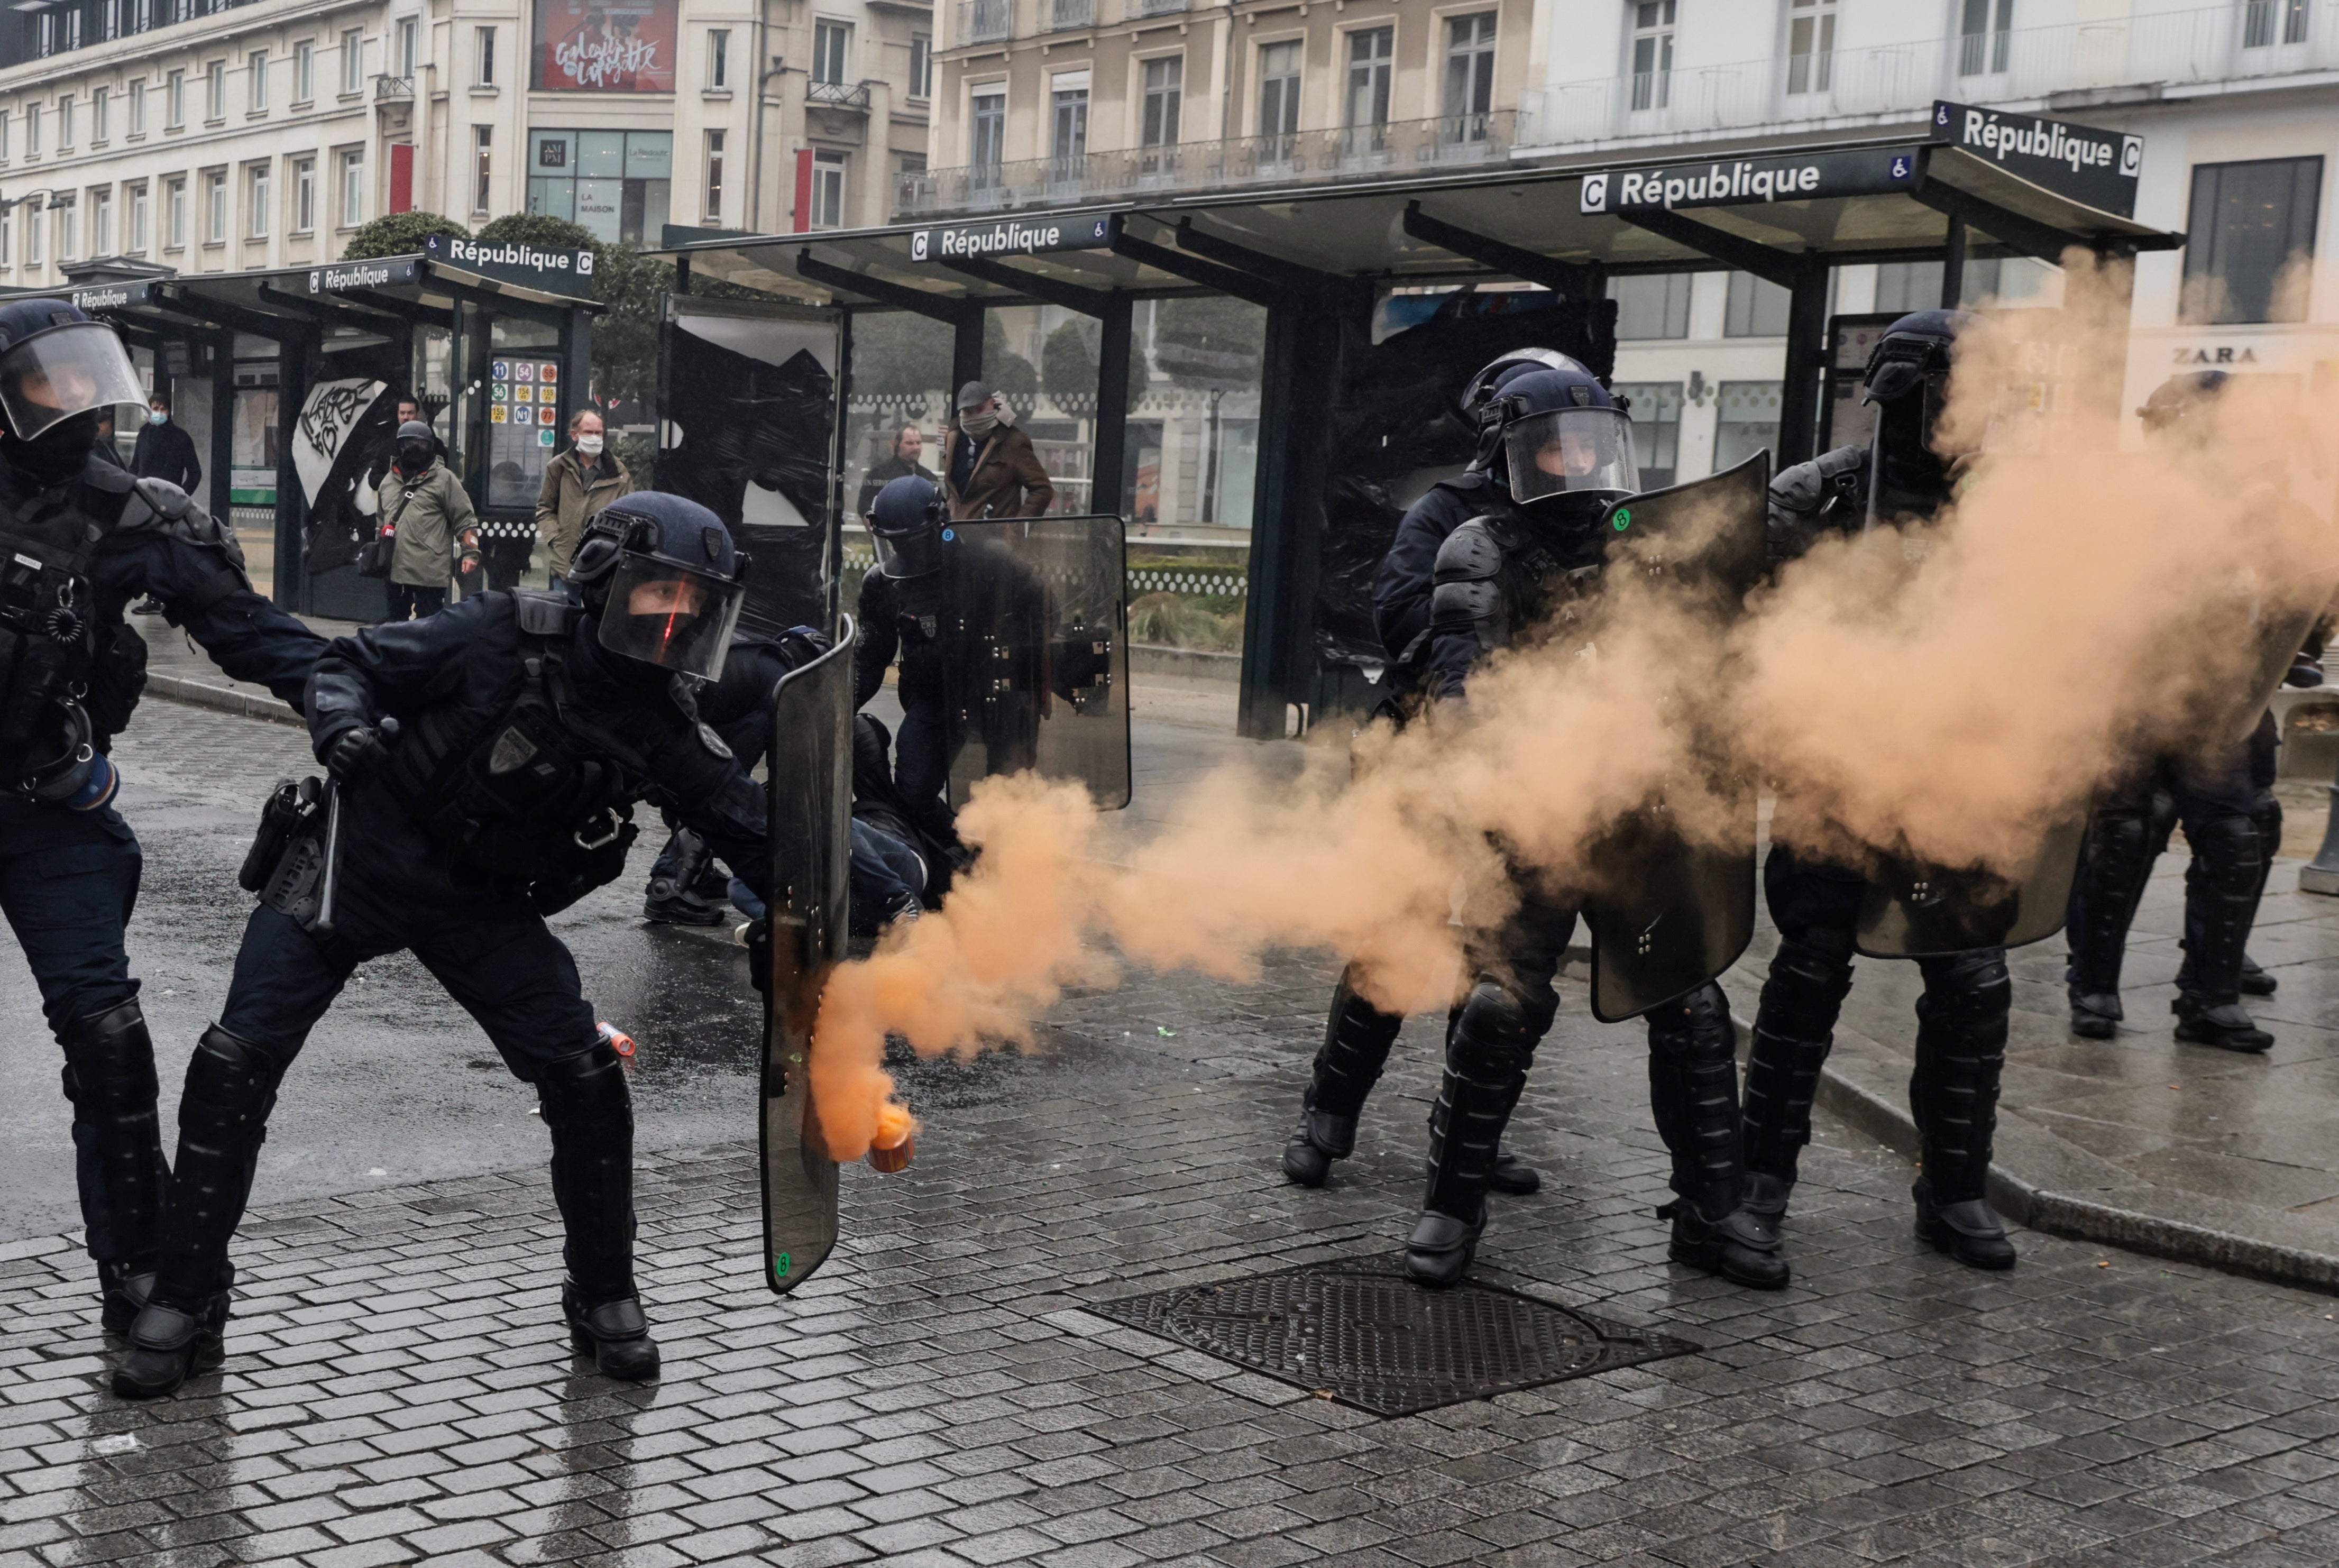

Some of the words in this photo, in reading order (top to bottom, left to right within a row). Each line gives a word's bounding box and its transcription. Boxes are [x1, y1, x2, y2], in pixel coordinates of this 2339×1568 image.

[1964, 109, 2114, 172] République
[2125, 142, 2139, 170] C
[1585, 180, 1603, 207] C
[1620, 162, 1820, 210] République
[914, 235, 925, 256] C
[942, 223, 1060, 259] République
[451, 239, 569, 272] République
[579, 255, 591, 271] C
[311, 275, 317, 290] C
[326, 266, 388, 291] République
[82, 289, 127, 310] République
[2172, 346, 2258, 365] ZARA
[495, 366, 504, 375] 11
[519, 368, 529, 377] 54
[544, 369, 554, 378] 55
[494, 388, 503, 397] 56
[517, 410, 527, 420] N1
[1617, 513, 1626, 526] 8
[781, 1257, 786, 1272] 8
